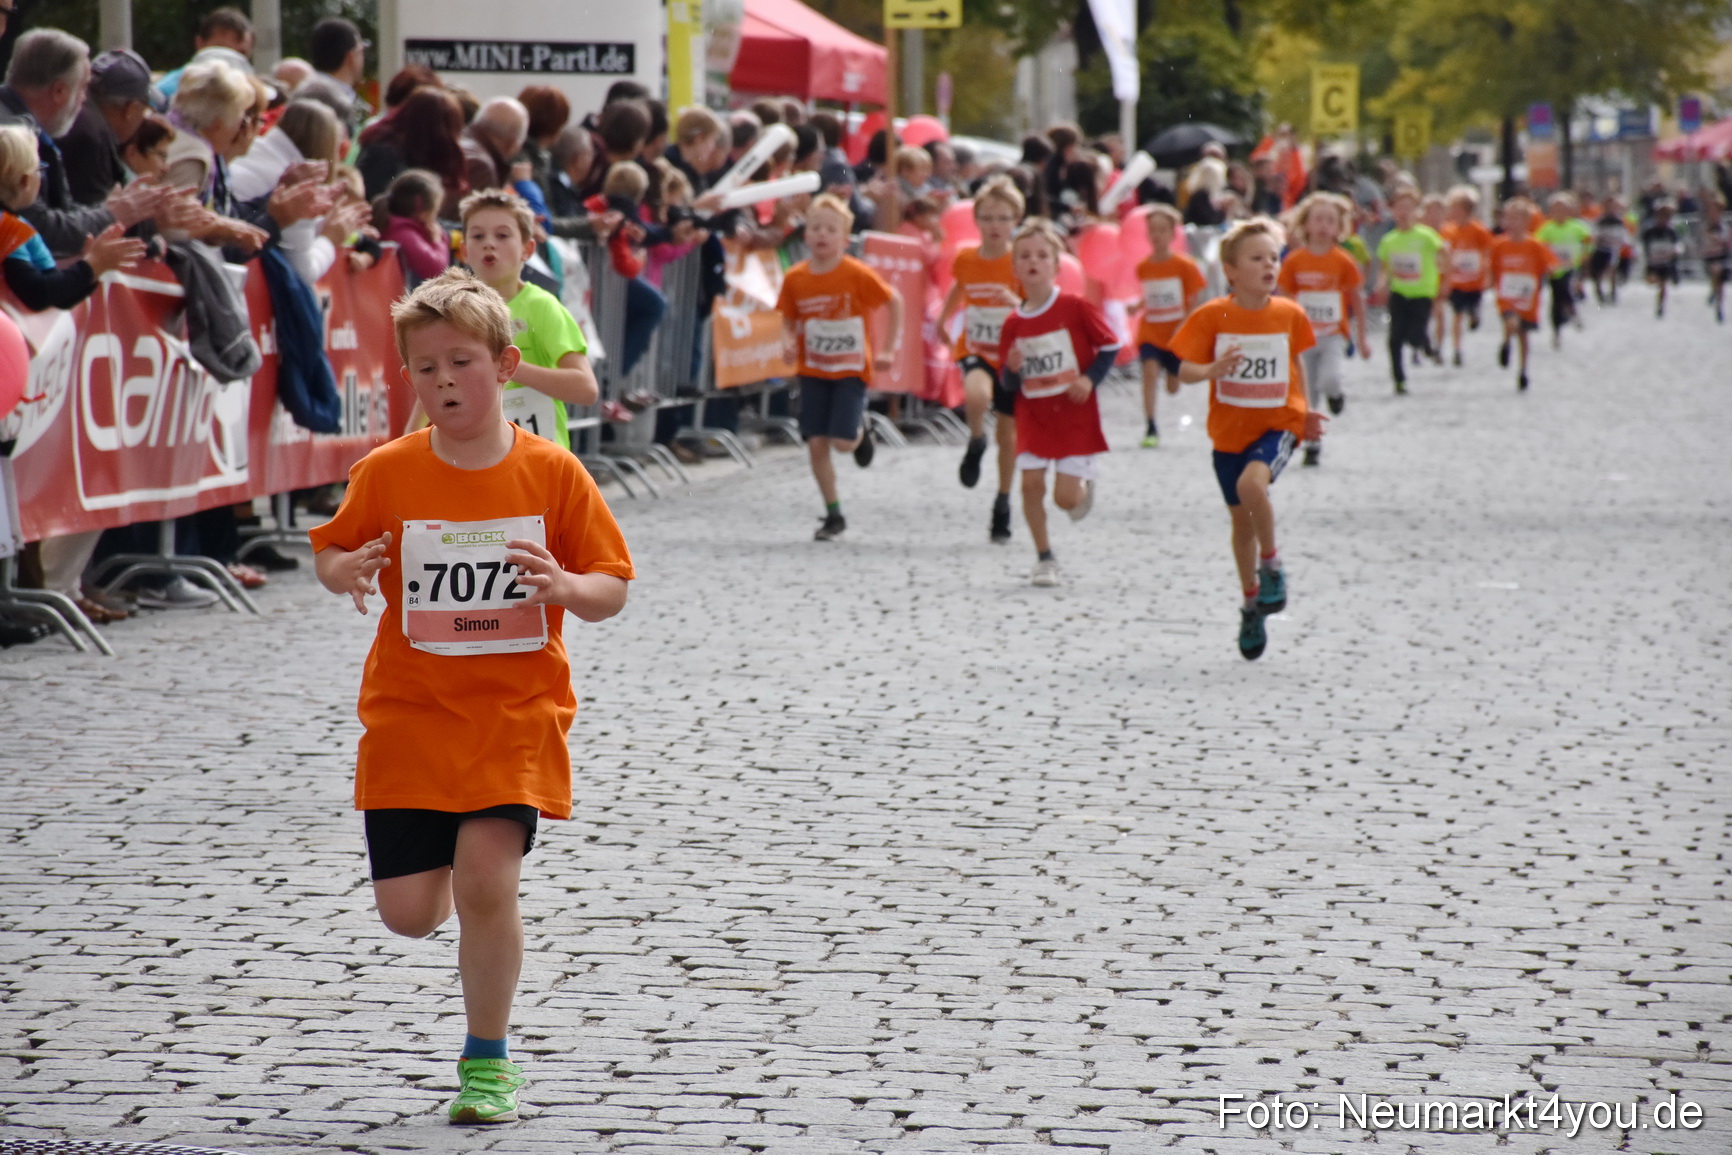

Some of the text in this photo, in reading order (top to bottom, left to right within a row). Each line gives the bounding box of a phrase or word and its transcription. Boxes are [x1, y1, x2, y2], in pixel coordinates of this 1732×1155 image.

[1323, 85, 1345, 118] C
[456, 531, 506, 544] BOCK
[423, 561, 526, 602] 7072
[409, 597, 419, 605] B4
[453, 617, 500, 632] Simon
